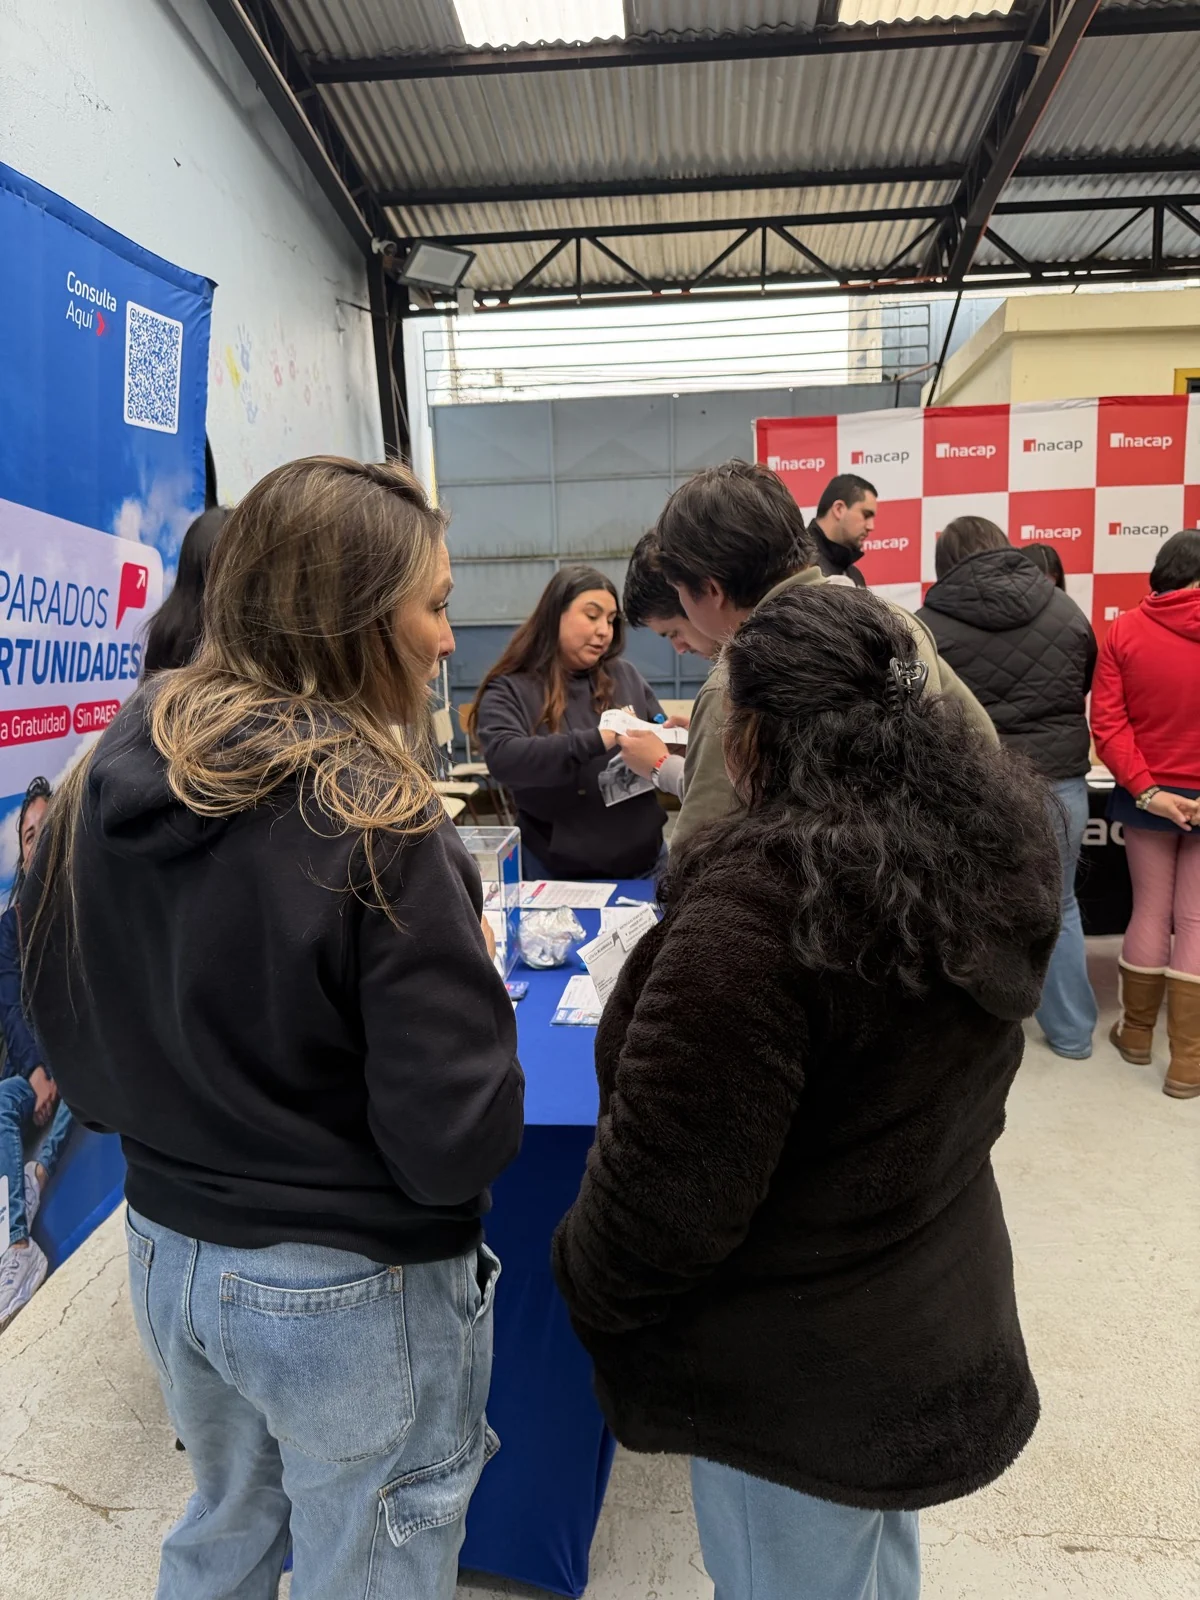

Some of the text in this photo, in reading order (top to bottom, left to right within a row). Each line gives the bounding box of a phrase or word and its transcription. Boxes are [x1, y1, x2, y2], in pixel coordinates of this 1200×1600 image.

[67, 271, 117, 312] Consulta
[66, 300, 94, 329] Aquí
[861, 537, 909, 551] nacap
[11, 711, 67, 739] Gratuidad
[77, 708, 92, 728] Sin
